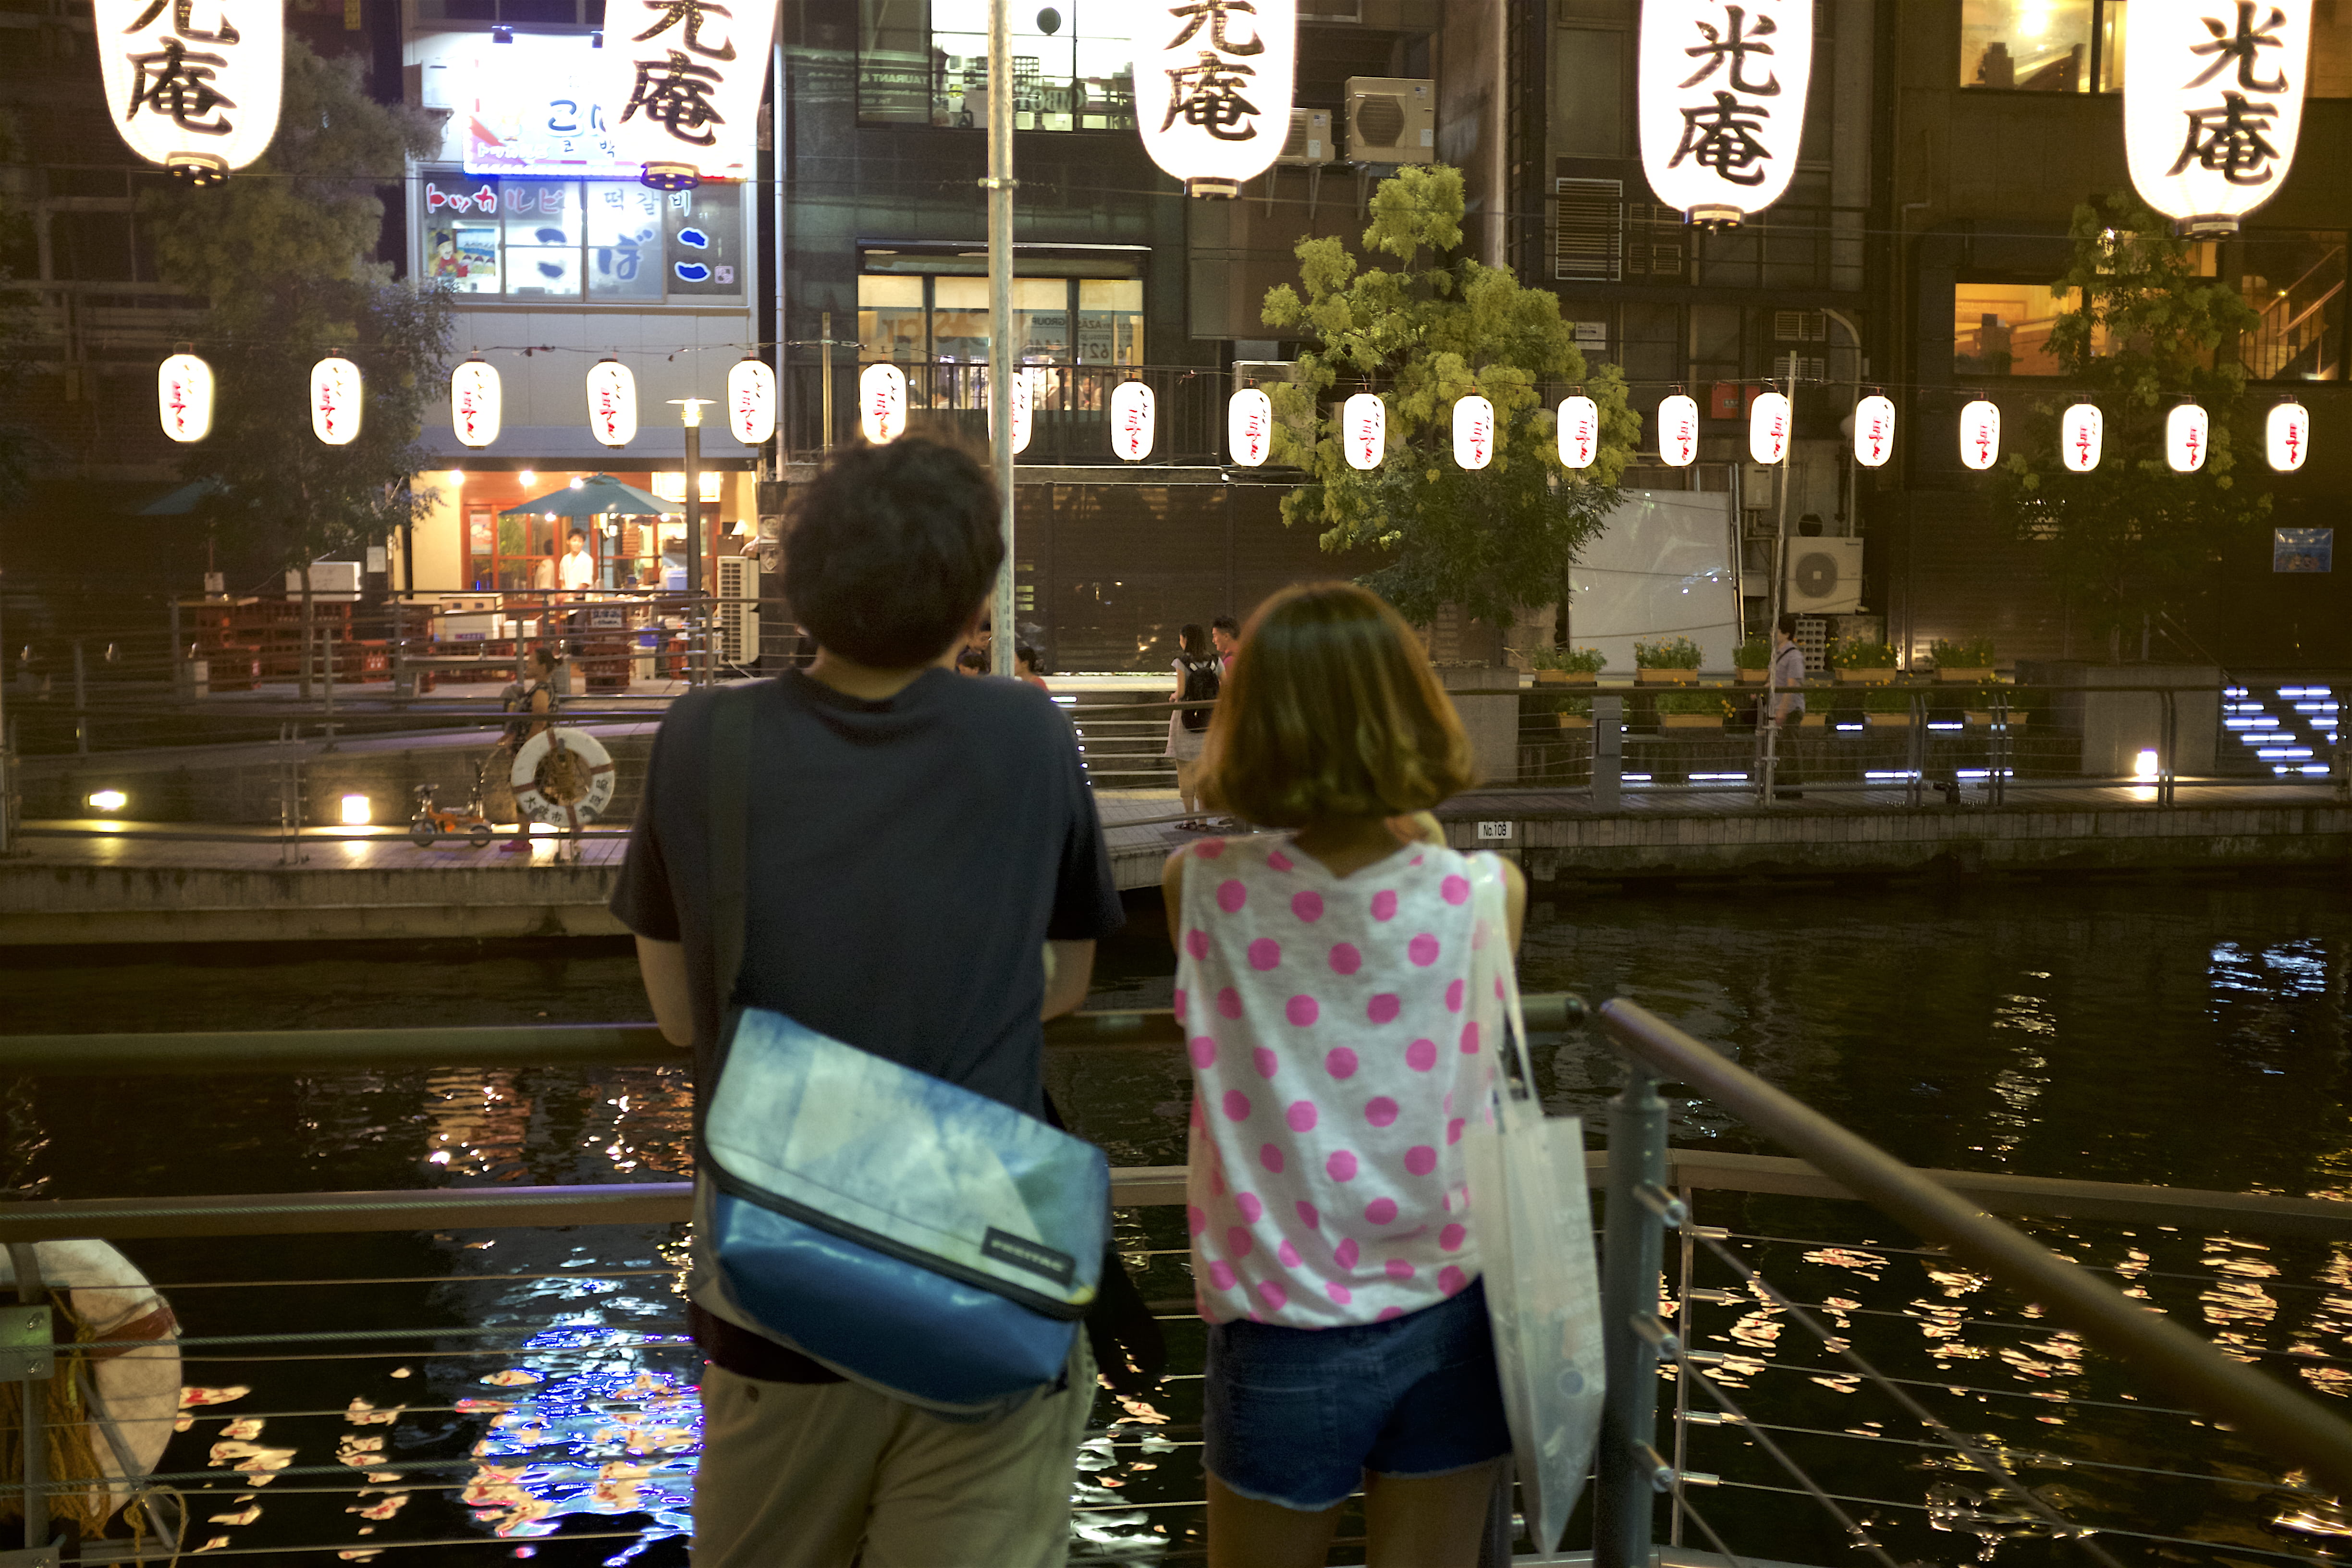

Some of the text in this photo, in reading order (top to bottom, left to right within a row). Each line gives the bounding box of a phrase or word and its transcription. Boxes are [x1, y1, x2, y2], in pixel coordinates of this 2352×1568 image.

[1666, 5, 1781, 186] 光庵
[2165, 0, 2289, 186] 光庵
[426, 183, 564, 214] トッカルビ
[1483, 823, 1507, 836] No.108
